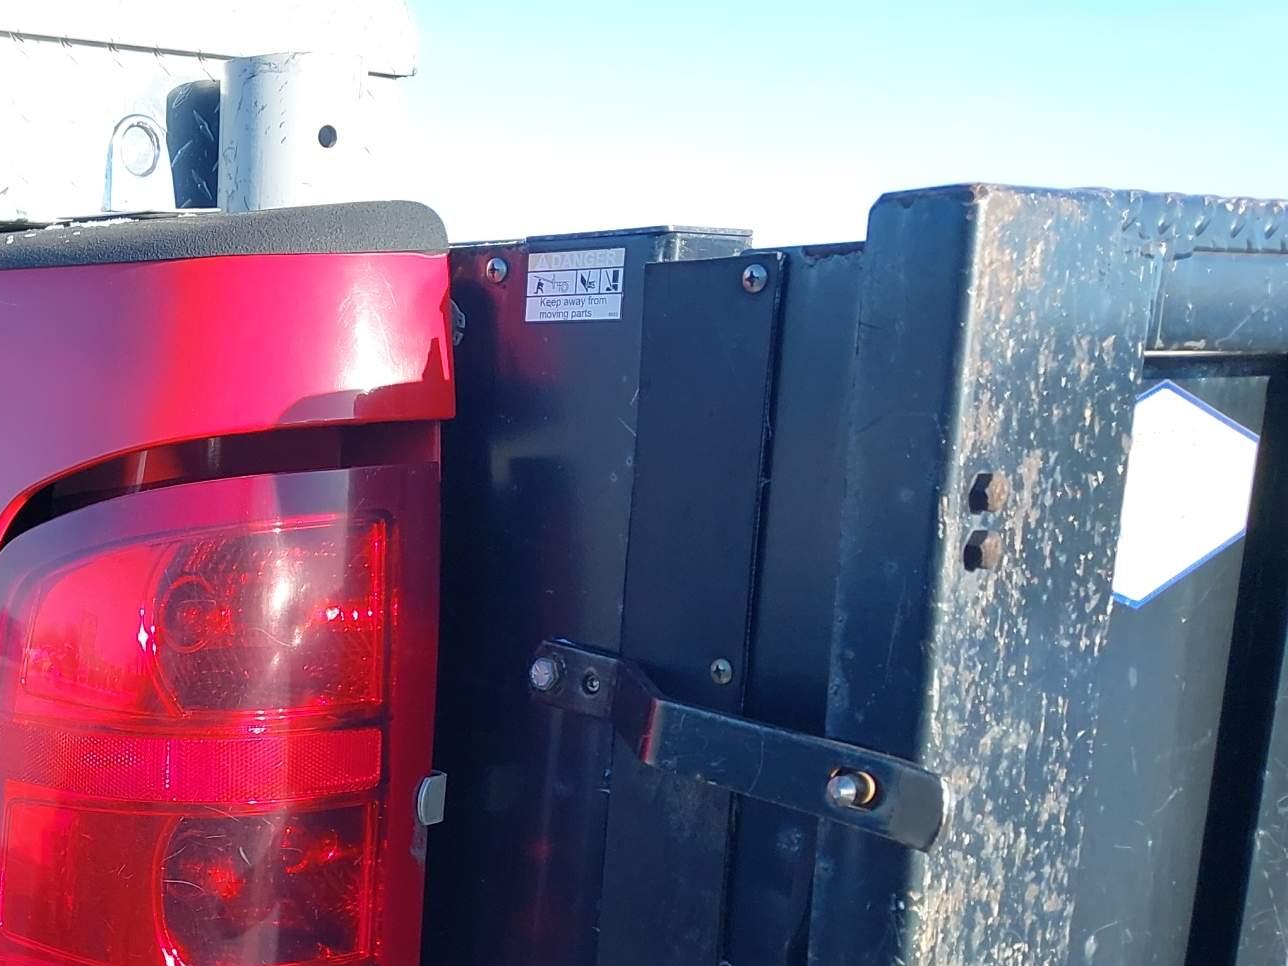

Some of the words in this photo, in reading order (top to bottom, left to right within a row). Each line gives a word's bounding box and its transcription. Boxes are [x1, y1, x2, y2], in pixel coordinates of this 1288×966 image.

[552, 251, 617, 268] DANGER
[540, 297, 562, 308] Keep
[563, 298, 586, 307] away
[588, 296, 607, 305] from
[539, 309, 569, 320] moving
[571, 308, 592, 319] parts
